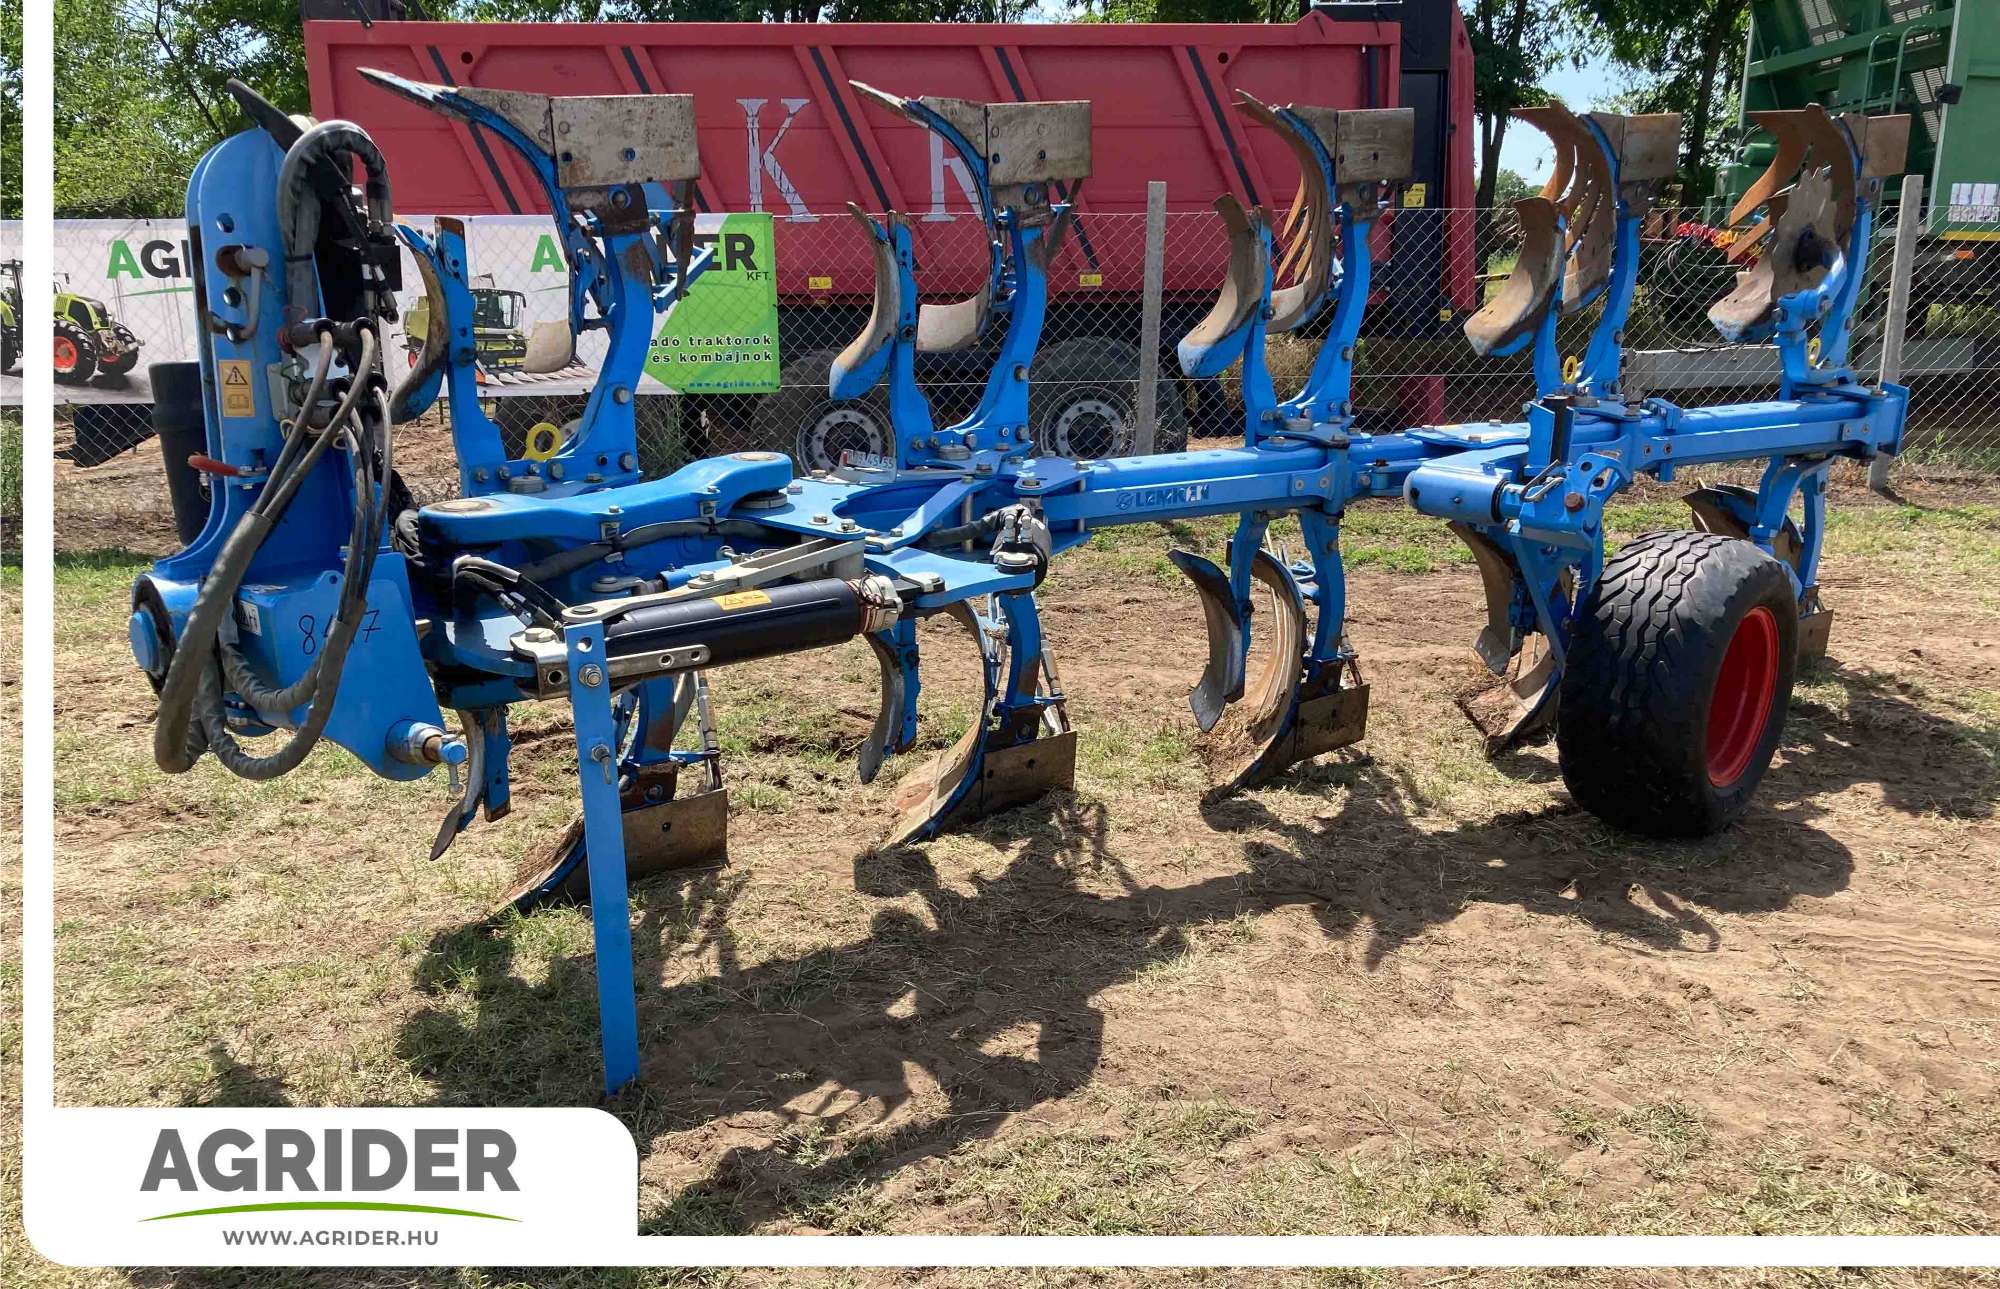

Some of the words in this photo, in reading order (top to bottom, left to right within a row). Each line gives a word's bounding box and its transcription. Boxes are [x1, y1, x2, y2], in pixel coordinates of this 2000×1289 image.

[746, 271, 772, 281] KFT.
[650, 336, 680, 347] adó
[688, 335, 772, 347] traktorok
[652, 352, 671, 363] és
[679, 351, 772, 363] kombájnok
